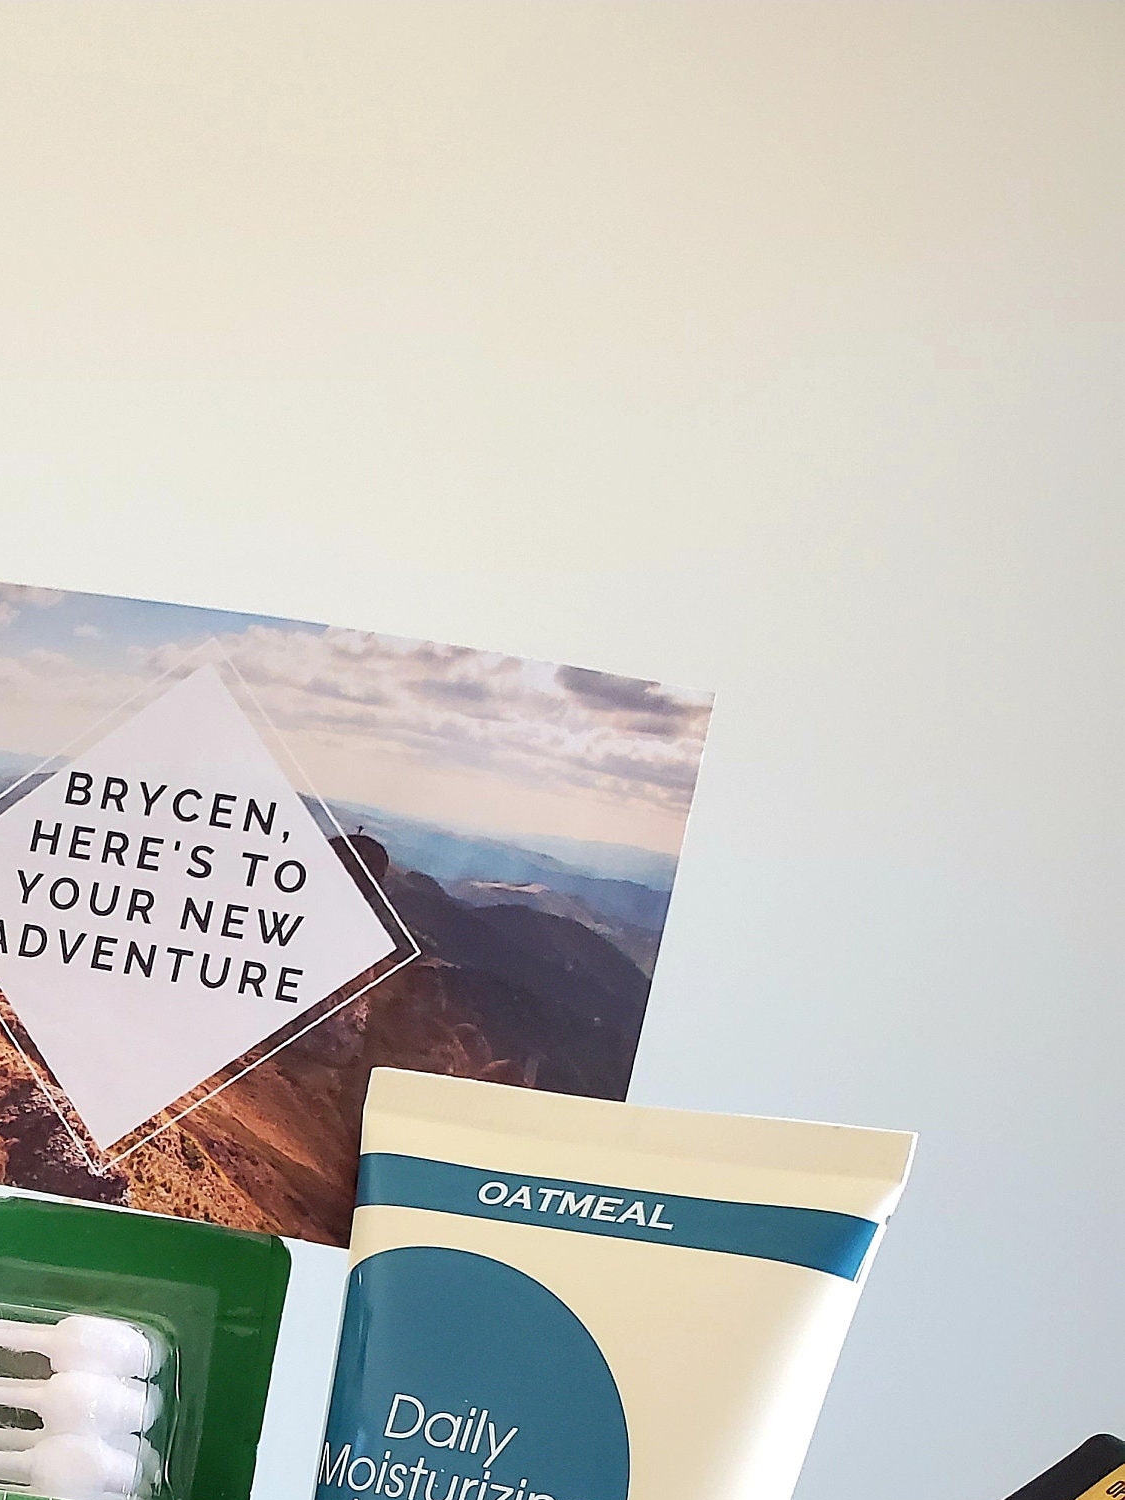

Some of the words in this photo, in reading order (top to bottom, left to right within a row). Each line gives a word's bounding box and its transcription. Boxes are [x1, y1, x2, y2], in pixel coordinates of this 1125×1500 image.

[65, 771, 291, 843] BRYCEN,
[30, 820, 214, 878] HERE'S
[242, 852, 306, 893] TO
[17, 870, 154, 924] YOUR
[181, 898, 304, 947] NEW
[476, 1181, 674, 1230] OATMEAL
[383, 1392, 518, 1467] Daily
